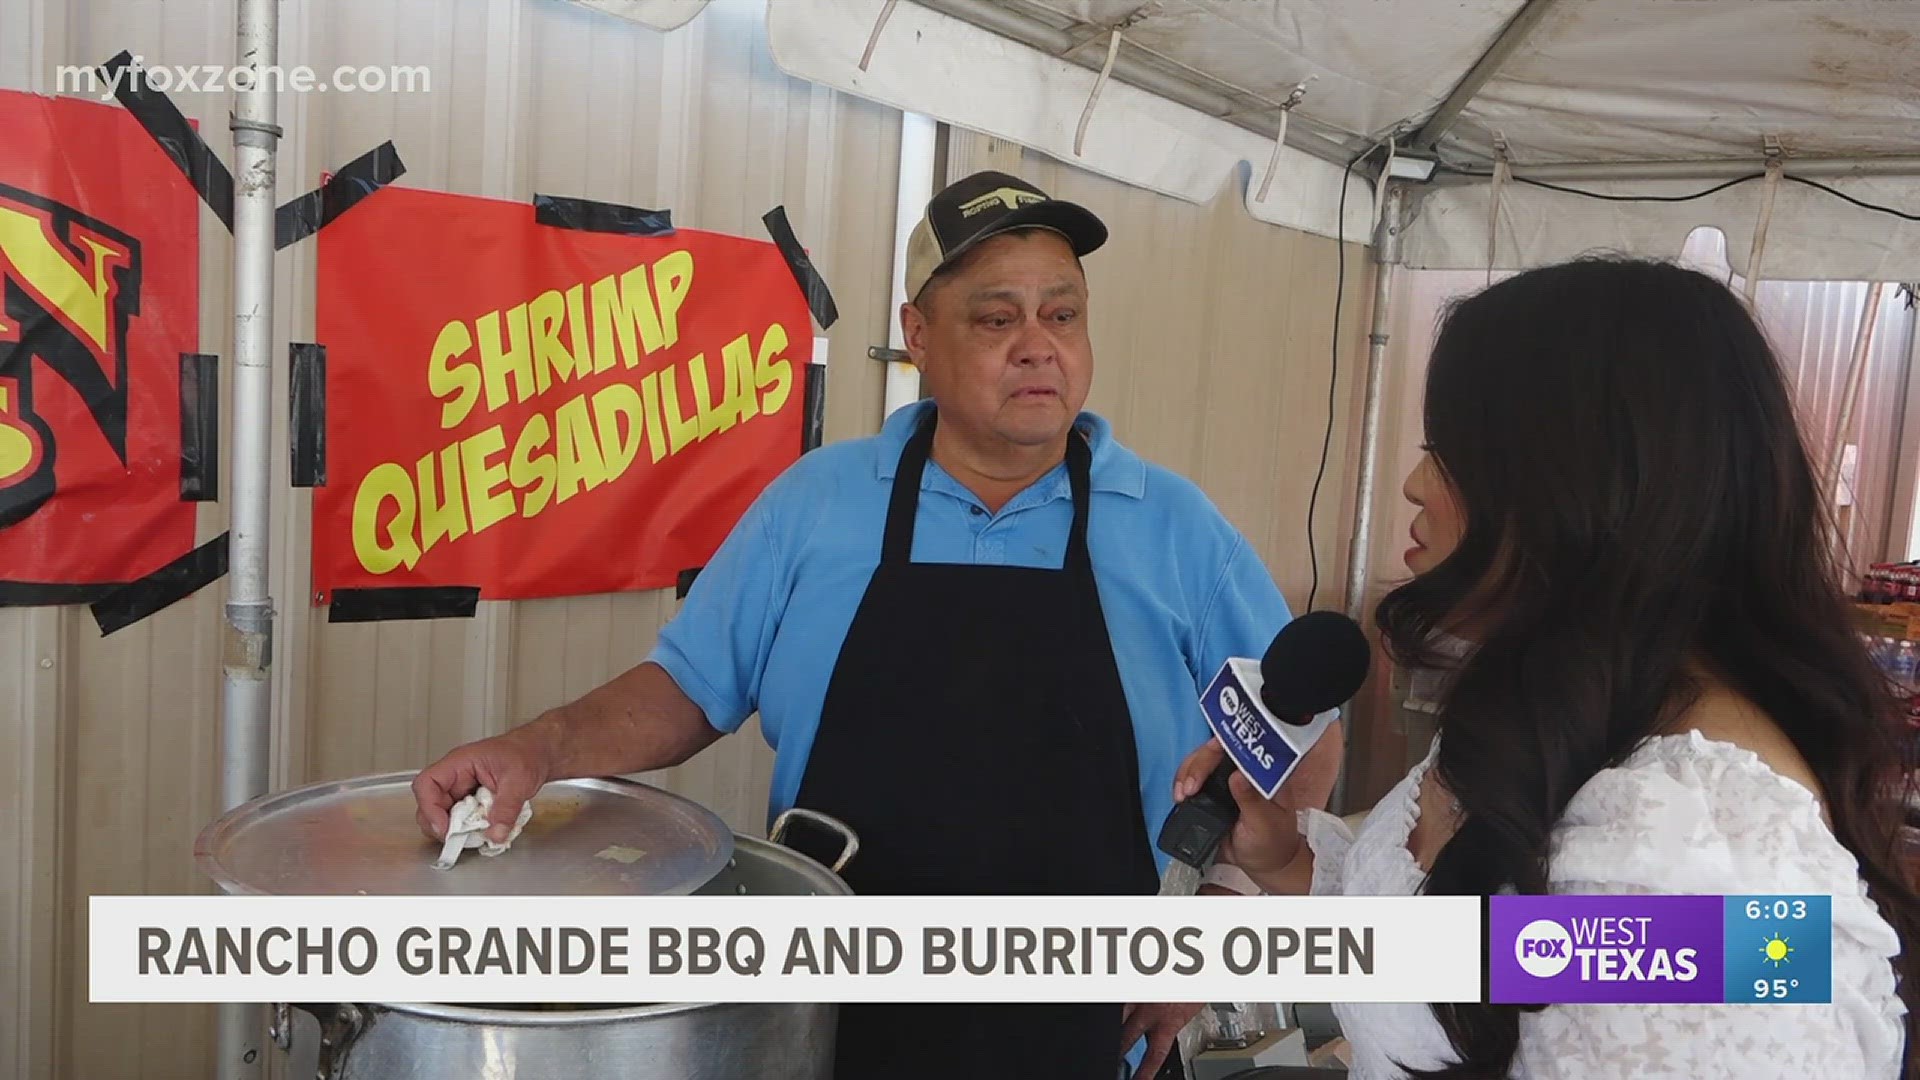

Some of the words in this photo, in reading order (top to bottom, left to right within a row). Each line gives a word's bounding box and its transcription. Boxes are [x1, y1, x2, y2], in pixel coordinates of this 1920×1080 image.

[428, 250, 694, 429] SHRIMP
[351, 323, 793, 575] QUESADILLAS
[1232, 714, 1274, 770] TEXAS
[1238, 702, 1266, 740] WEST
